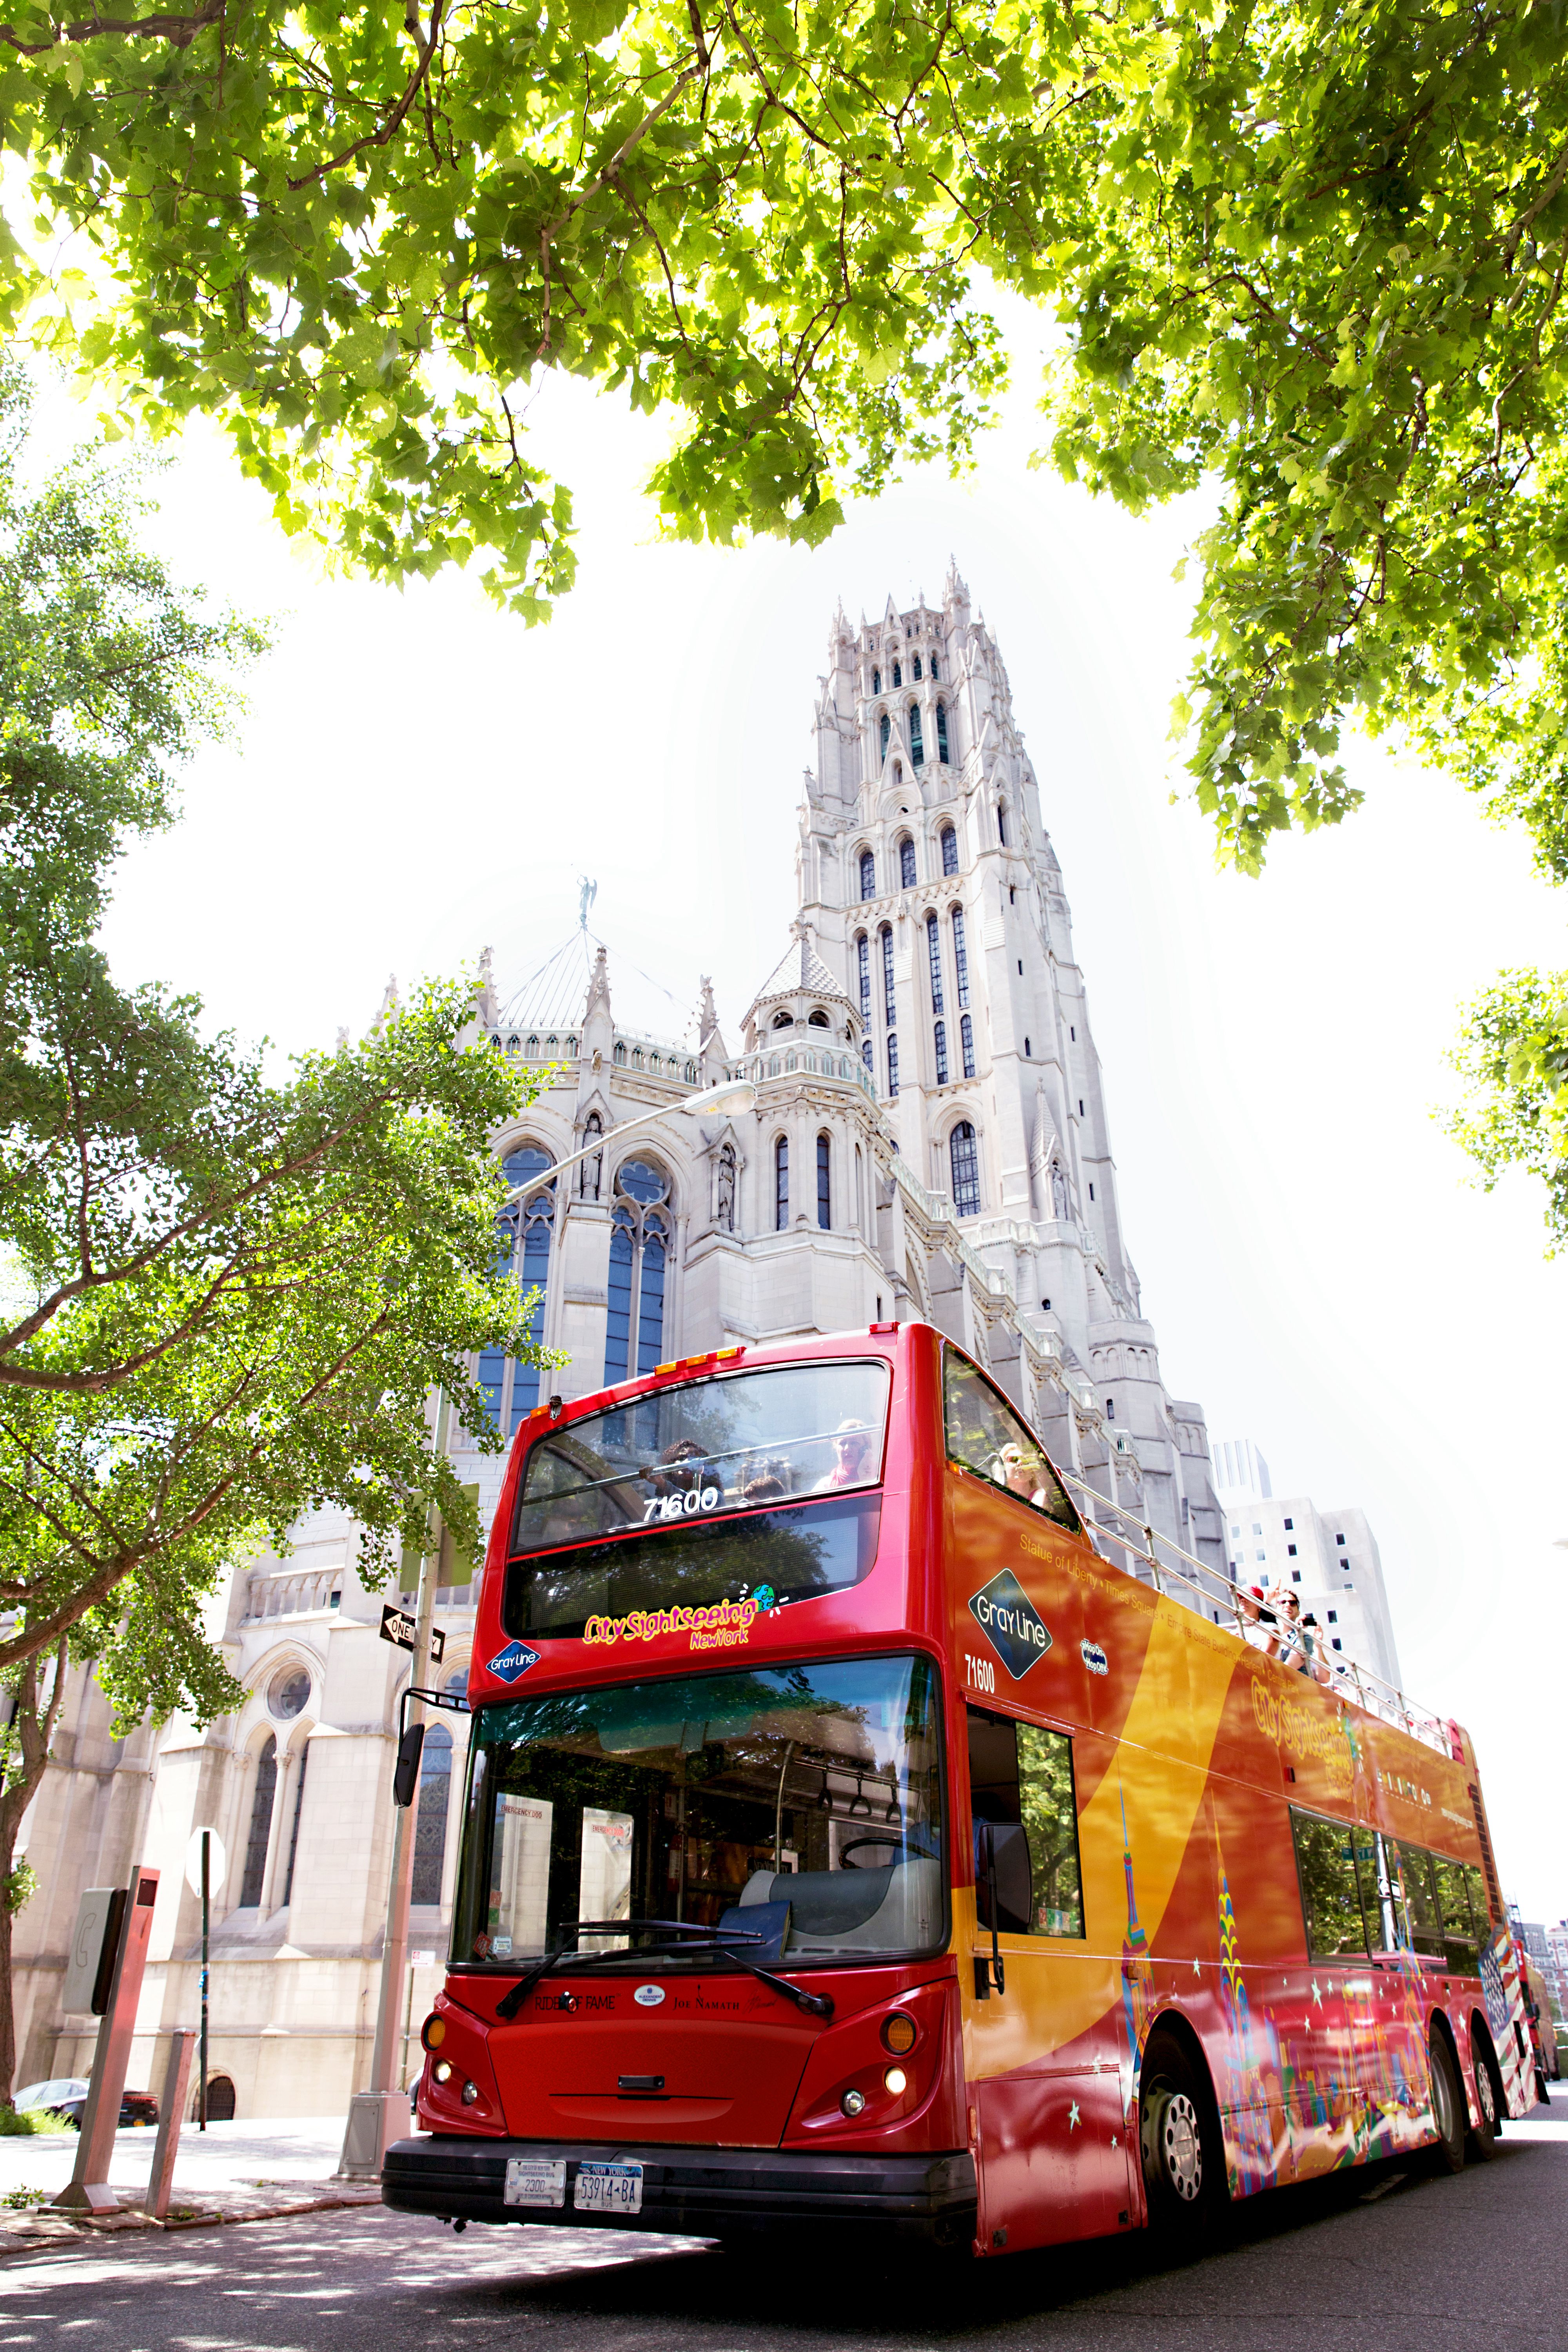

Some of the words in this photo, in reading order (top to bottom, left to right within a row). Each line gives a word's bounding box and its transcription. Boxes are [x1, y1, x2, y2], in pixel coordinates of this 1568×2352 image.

[644, 1487, 718, 1521] 71600
[1020, 1534, 1053, 1563] Statue
[1055, 1556, 1065, 1569] of
[1067, 1559, 1098, 1590] Liberty
[1105, 1579, 1129, 1604] Times
[1131, 1594, 1159, 1620] Square
[1167, 1614, 1191, 1637] Empire
[1193, 1629, 1210, 1648] State
[1212, 1639, 1236, 1664] Building
[1241, 1654, 1261, 1675] Harlem
[392, 1620, 410, 1639] ONE
[977, 1595, 1014, 1635] Gray
[1016, 1609, 1045, 1647] Line
[1085, 1640, 1095, 1655] Hop
[1095, 1645, 1103, 1658] On
[491, 1657, 515, 1670] Gray
[515, 1653, 536, 1666] Line
[1086, 1657, 1096, 1672] Hop
[965, 1653, 995, 1694] 71600
[501, 1805, 531, 1817] EMERGENCY
[593, 1826, 612, 1834] EMERGENCY
[586, 1996, 615, 2009] FAME
[593, 2165, 606, 2175] NEW
[608, 2166, 626, 2176] YORK
[525, 2179, 545, 2192] 2300
